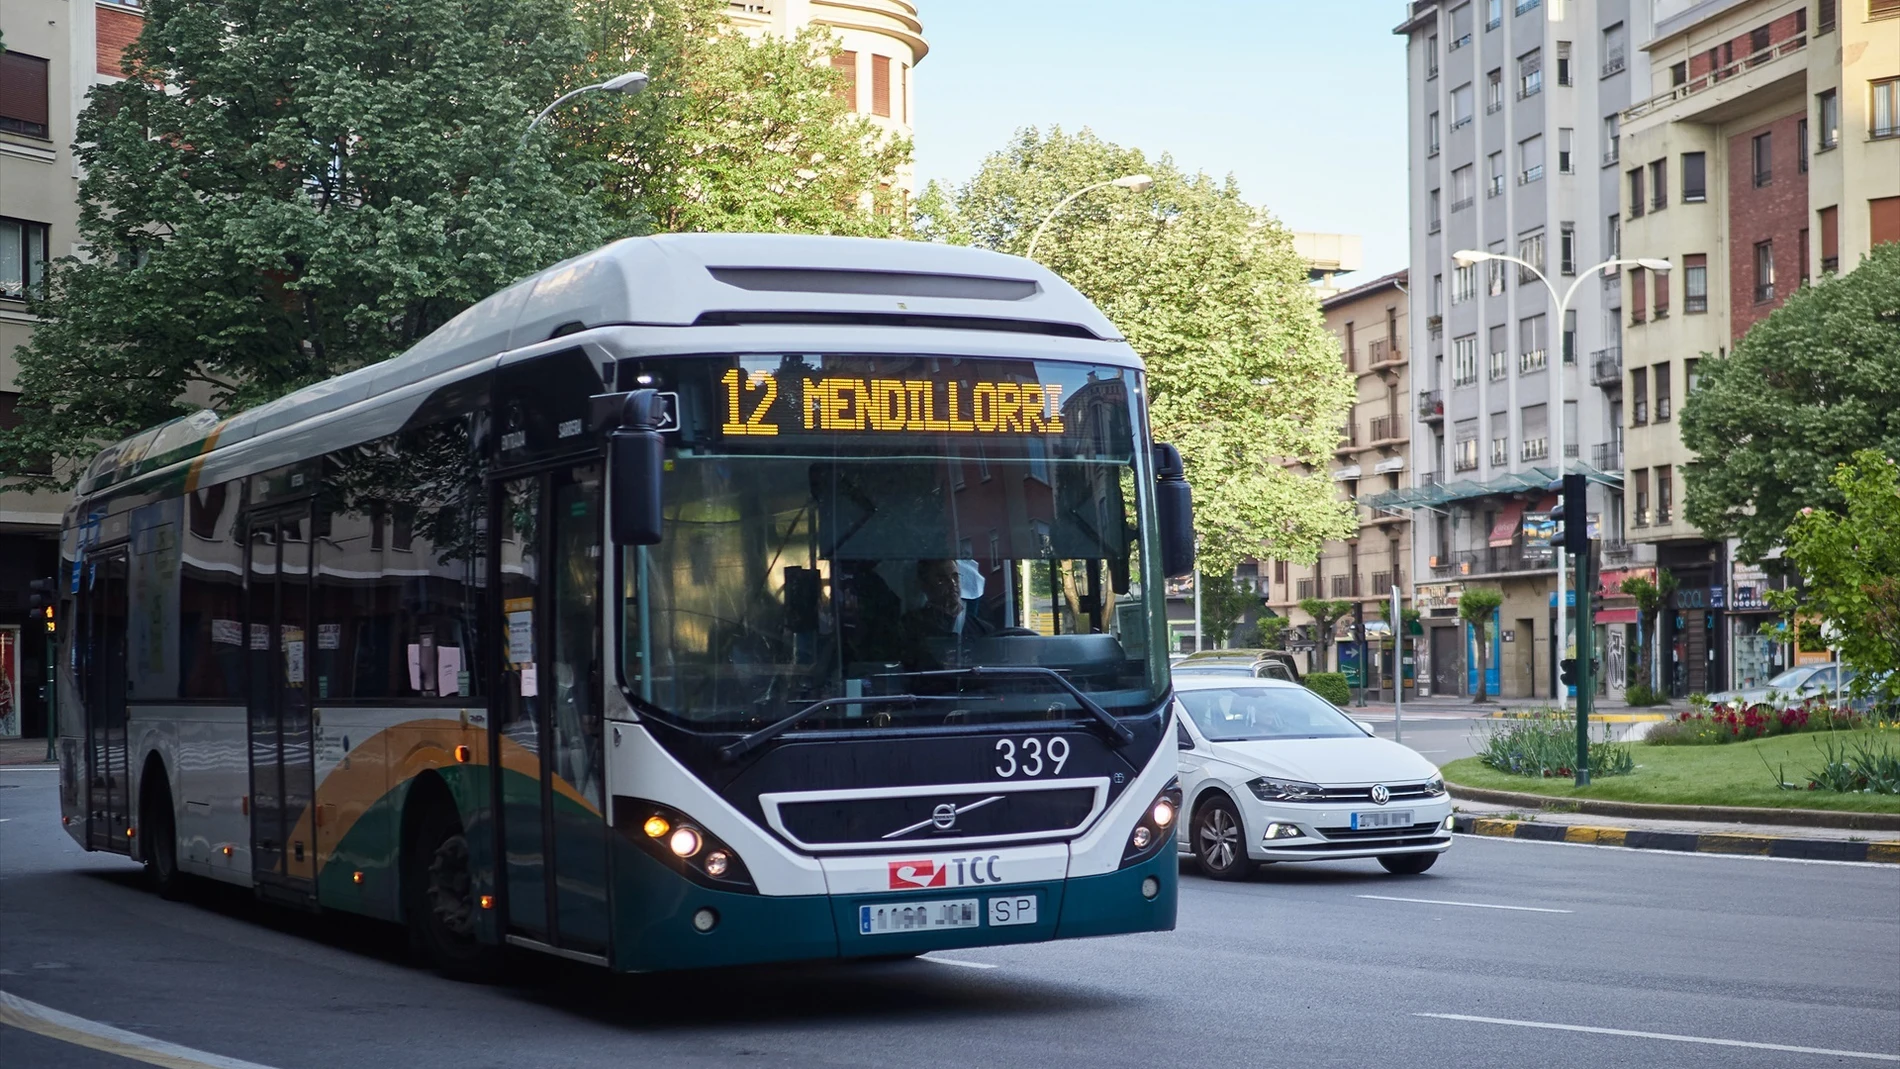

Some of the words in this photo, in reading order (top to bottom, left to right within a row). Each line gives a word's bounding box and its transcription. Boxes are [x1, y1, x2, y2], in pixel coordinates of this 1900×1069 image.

[721, 369, 779, 436] 12
[803, 378, 1065, 434] MENDILLORRI
[995, 736, 1070, 778] 339
[952, 855, 1002, 885] TCC
